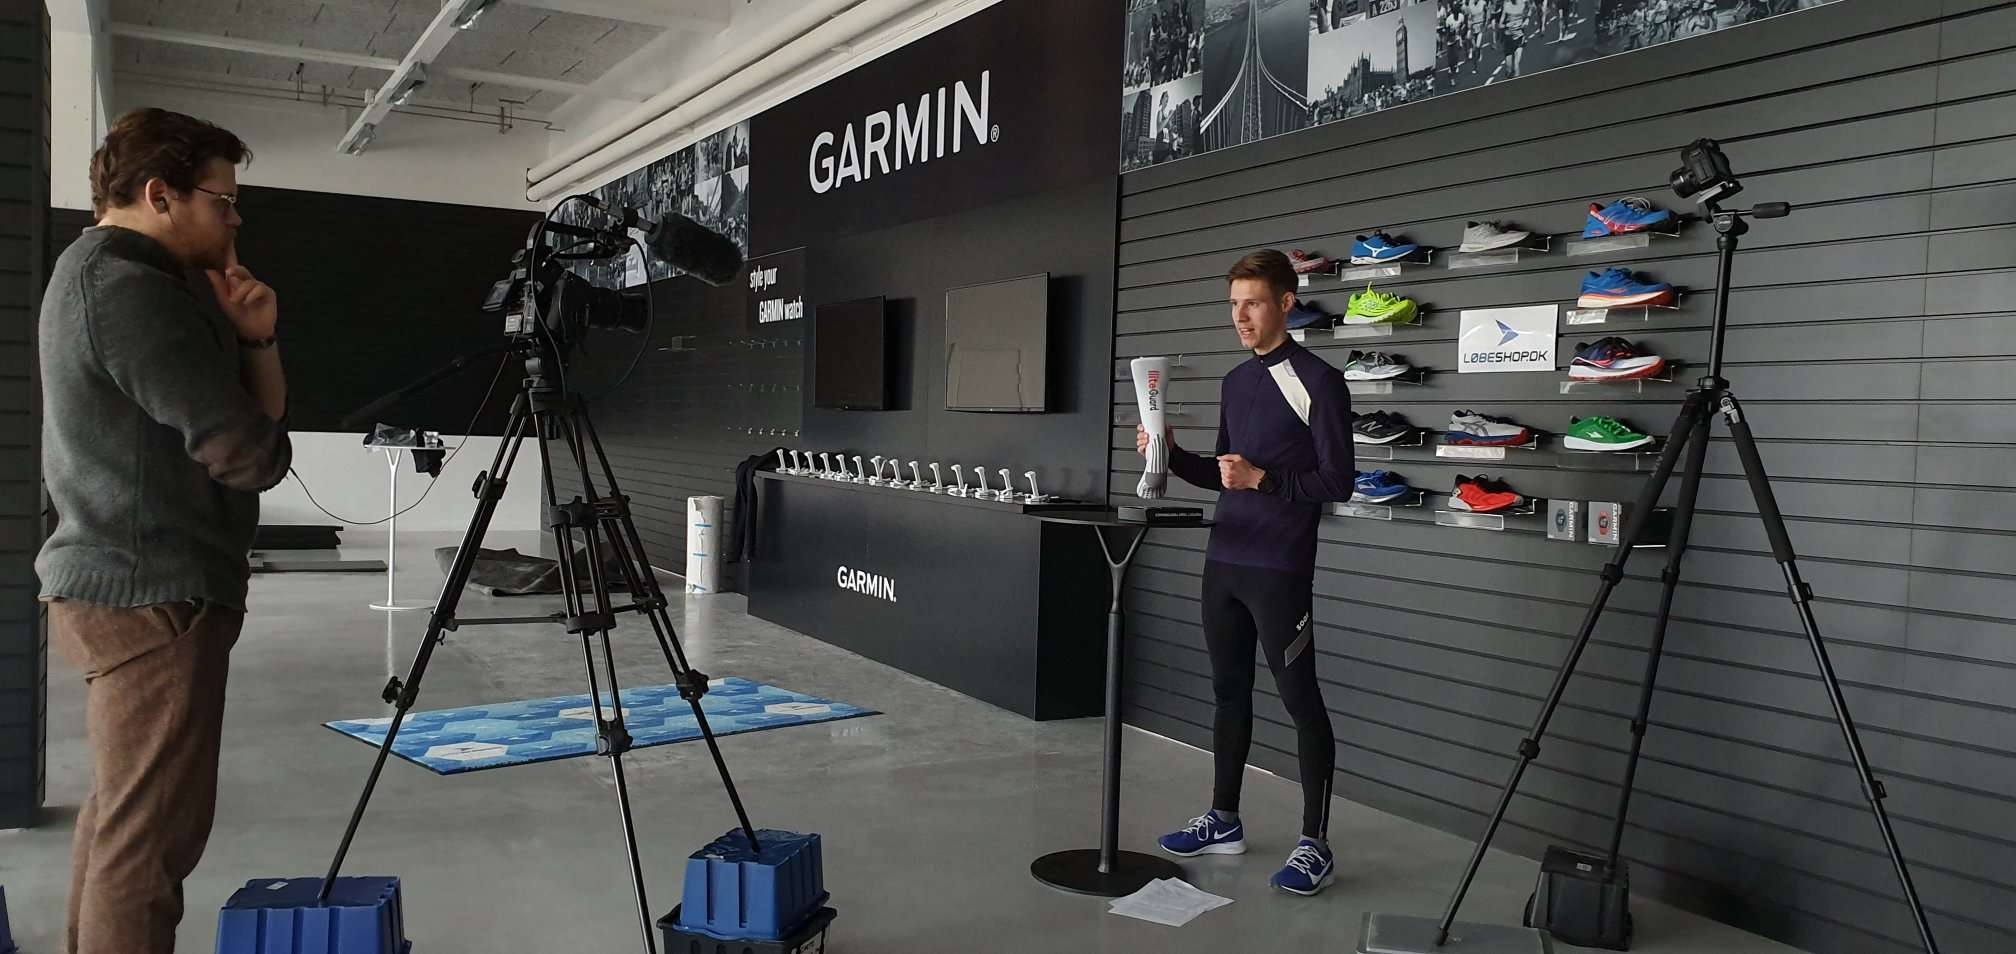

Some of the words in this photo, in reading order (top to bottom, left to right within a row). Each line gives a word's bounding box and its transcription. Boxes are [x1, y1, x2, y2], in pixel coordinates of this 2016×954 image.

[750, 264, 764, 293] style
[763, 267, 778, 291] your
[759, 298, 784, 323] GARMIN
[784, 295, 803, 320] watch
[1568, 501, 1576, 539] GARMIN
